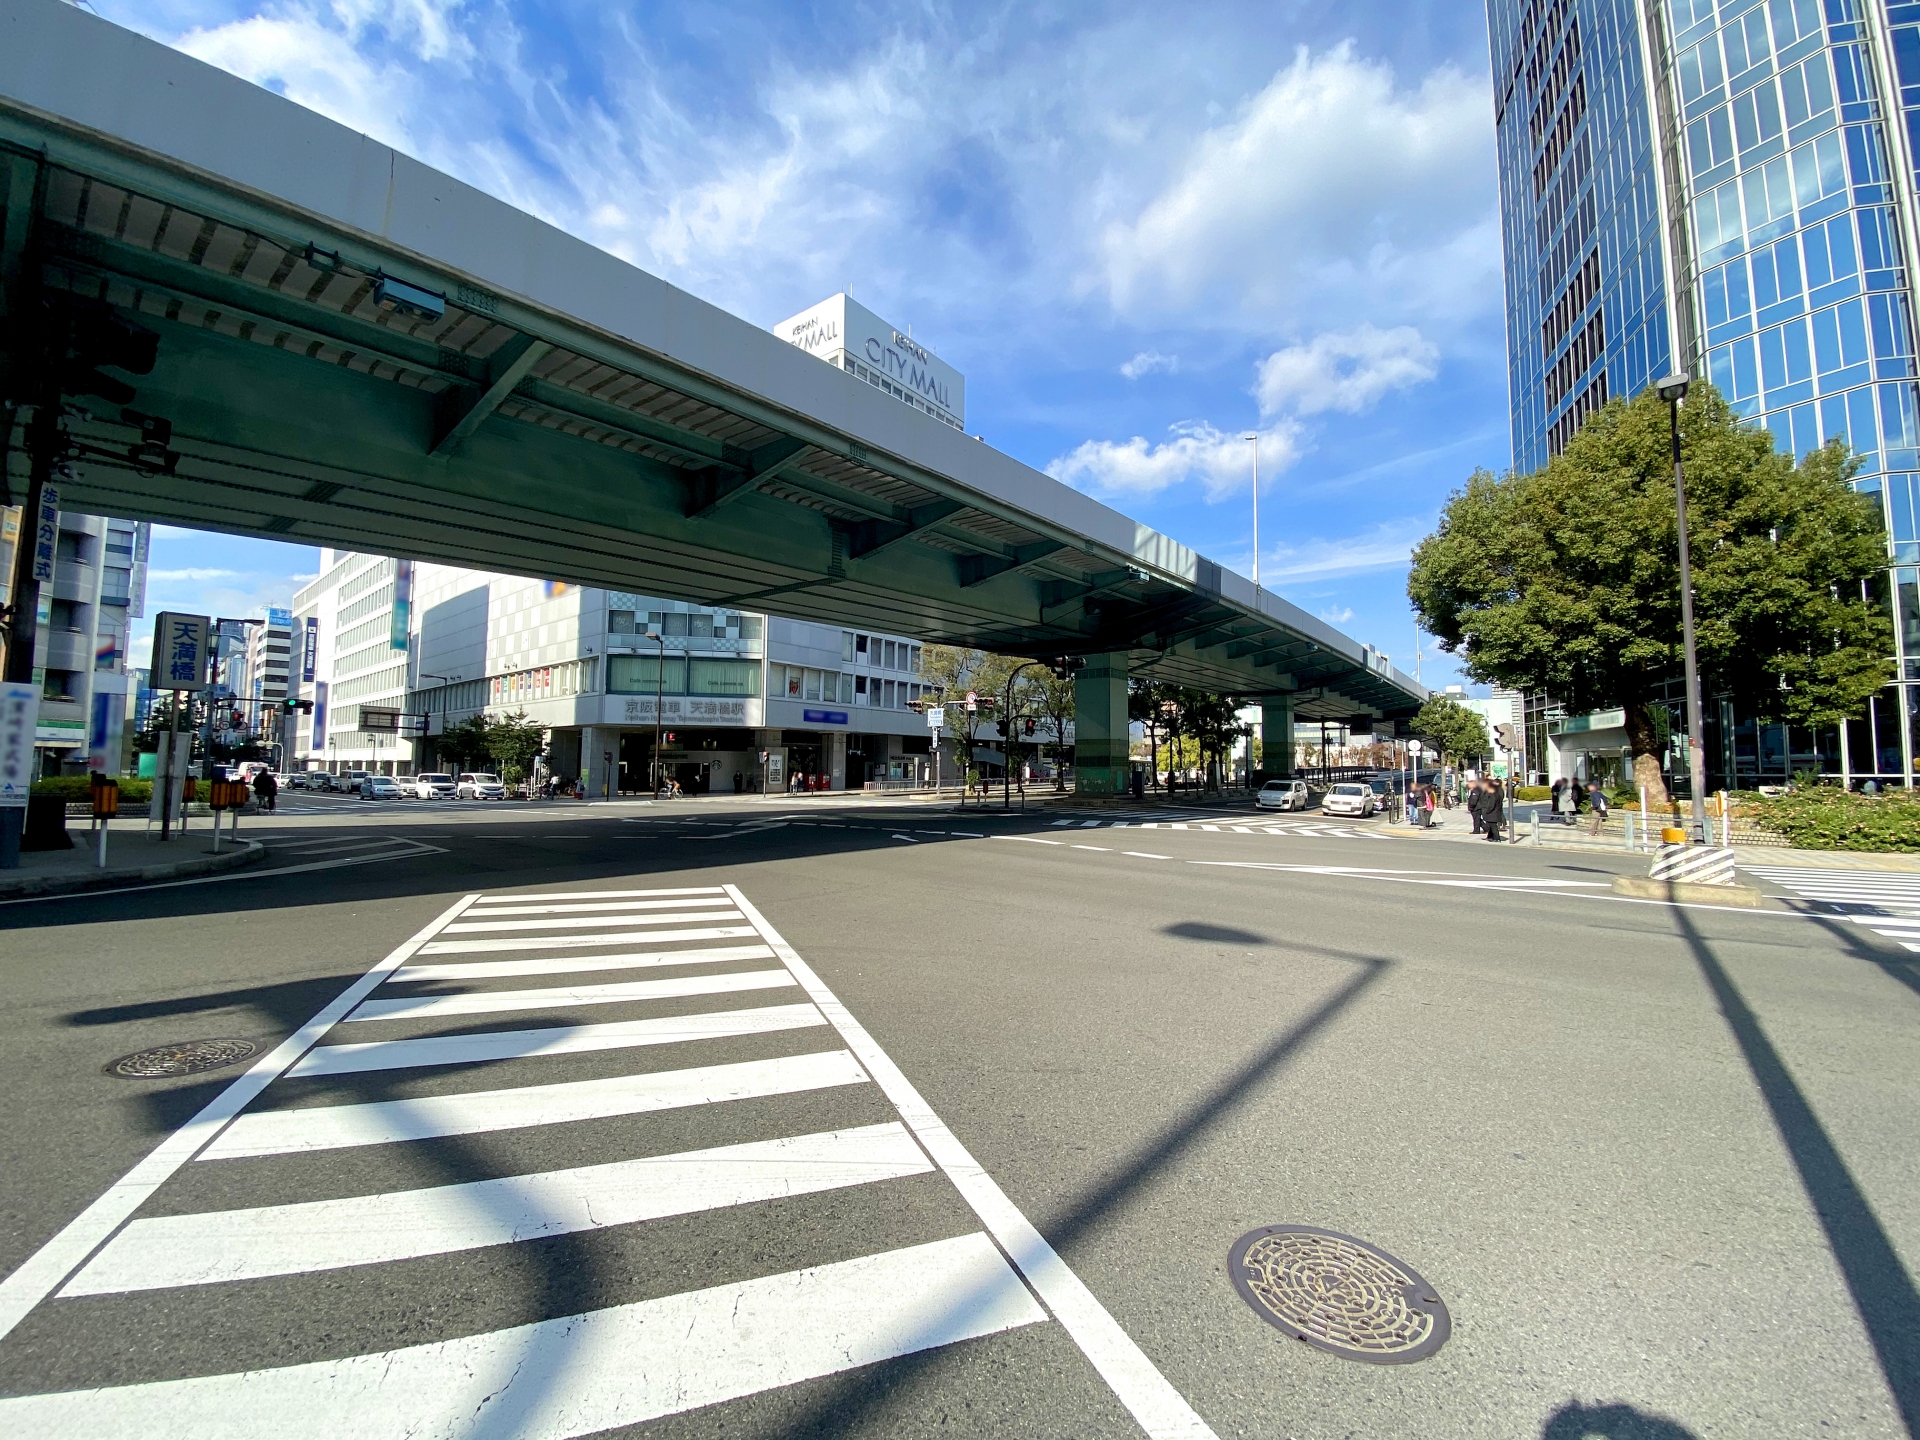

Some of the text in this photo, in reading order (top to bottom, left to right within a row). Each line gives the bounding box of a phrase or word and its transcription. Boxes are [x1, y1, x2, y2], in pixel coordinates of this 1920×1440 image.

[792, 316, 819, 336] KEIHAN
[804, 321, 838, 352] MALL
[893, 331, 927, 365] KEIHAN
[865, 337, 951, 409] CITY MALL
[35, 487, 58, 579] 歩車分離式
[170, 621, 199, 681] 天満橋
[625, 700, 744, 715] 京阪電車 天満橋駅
